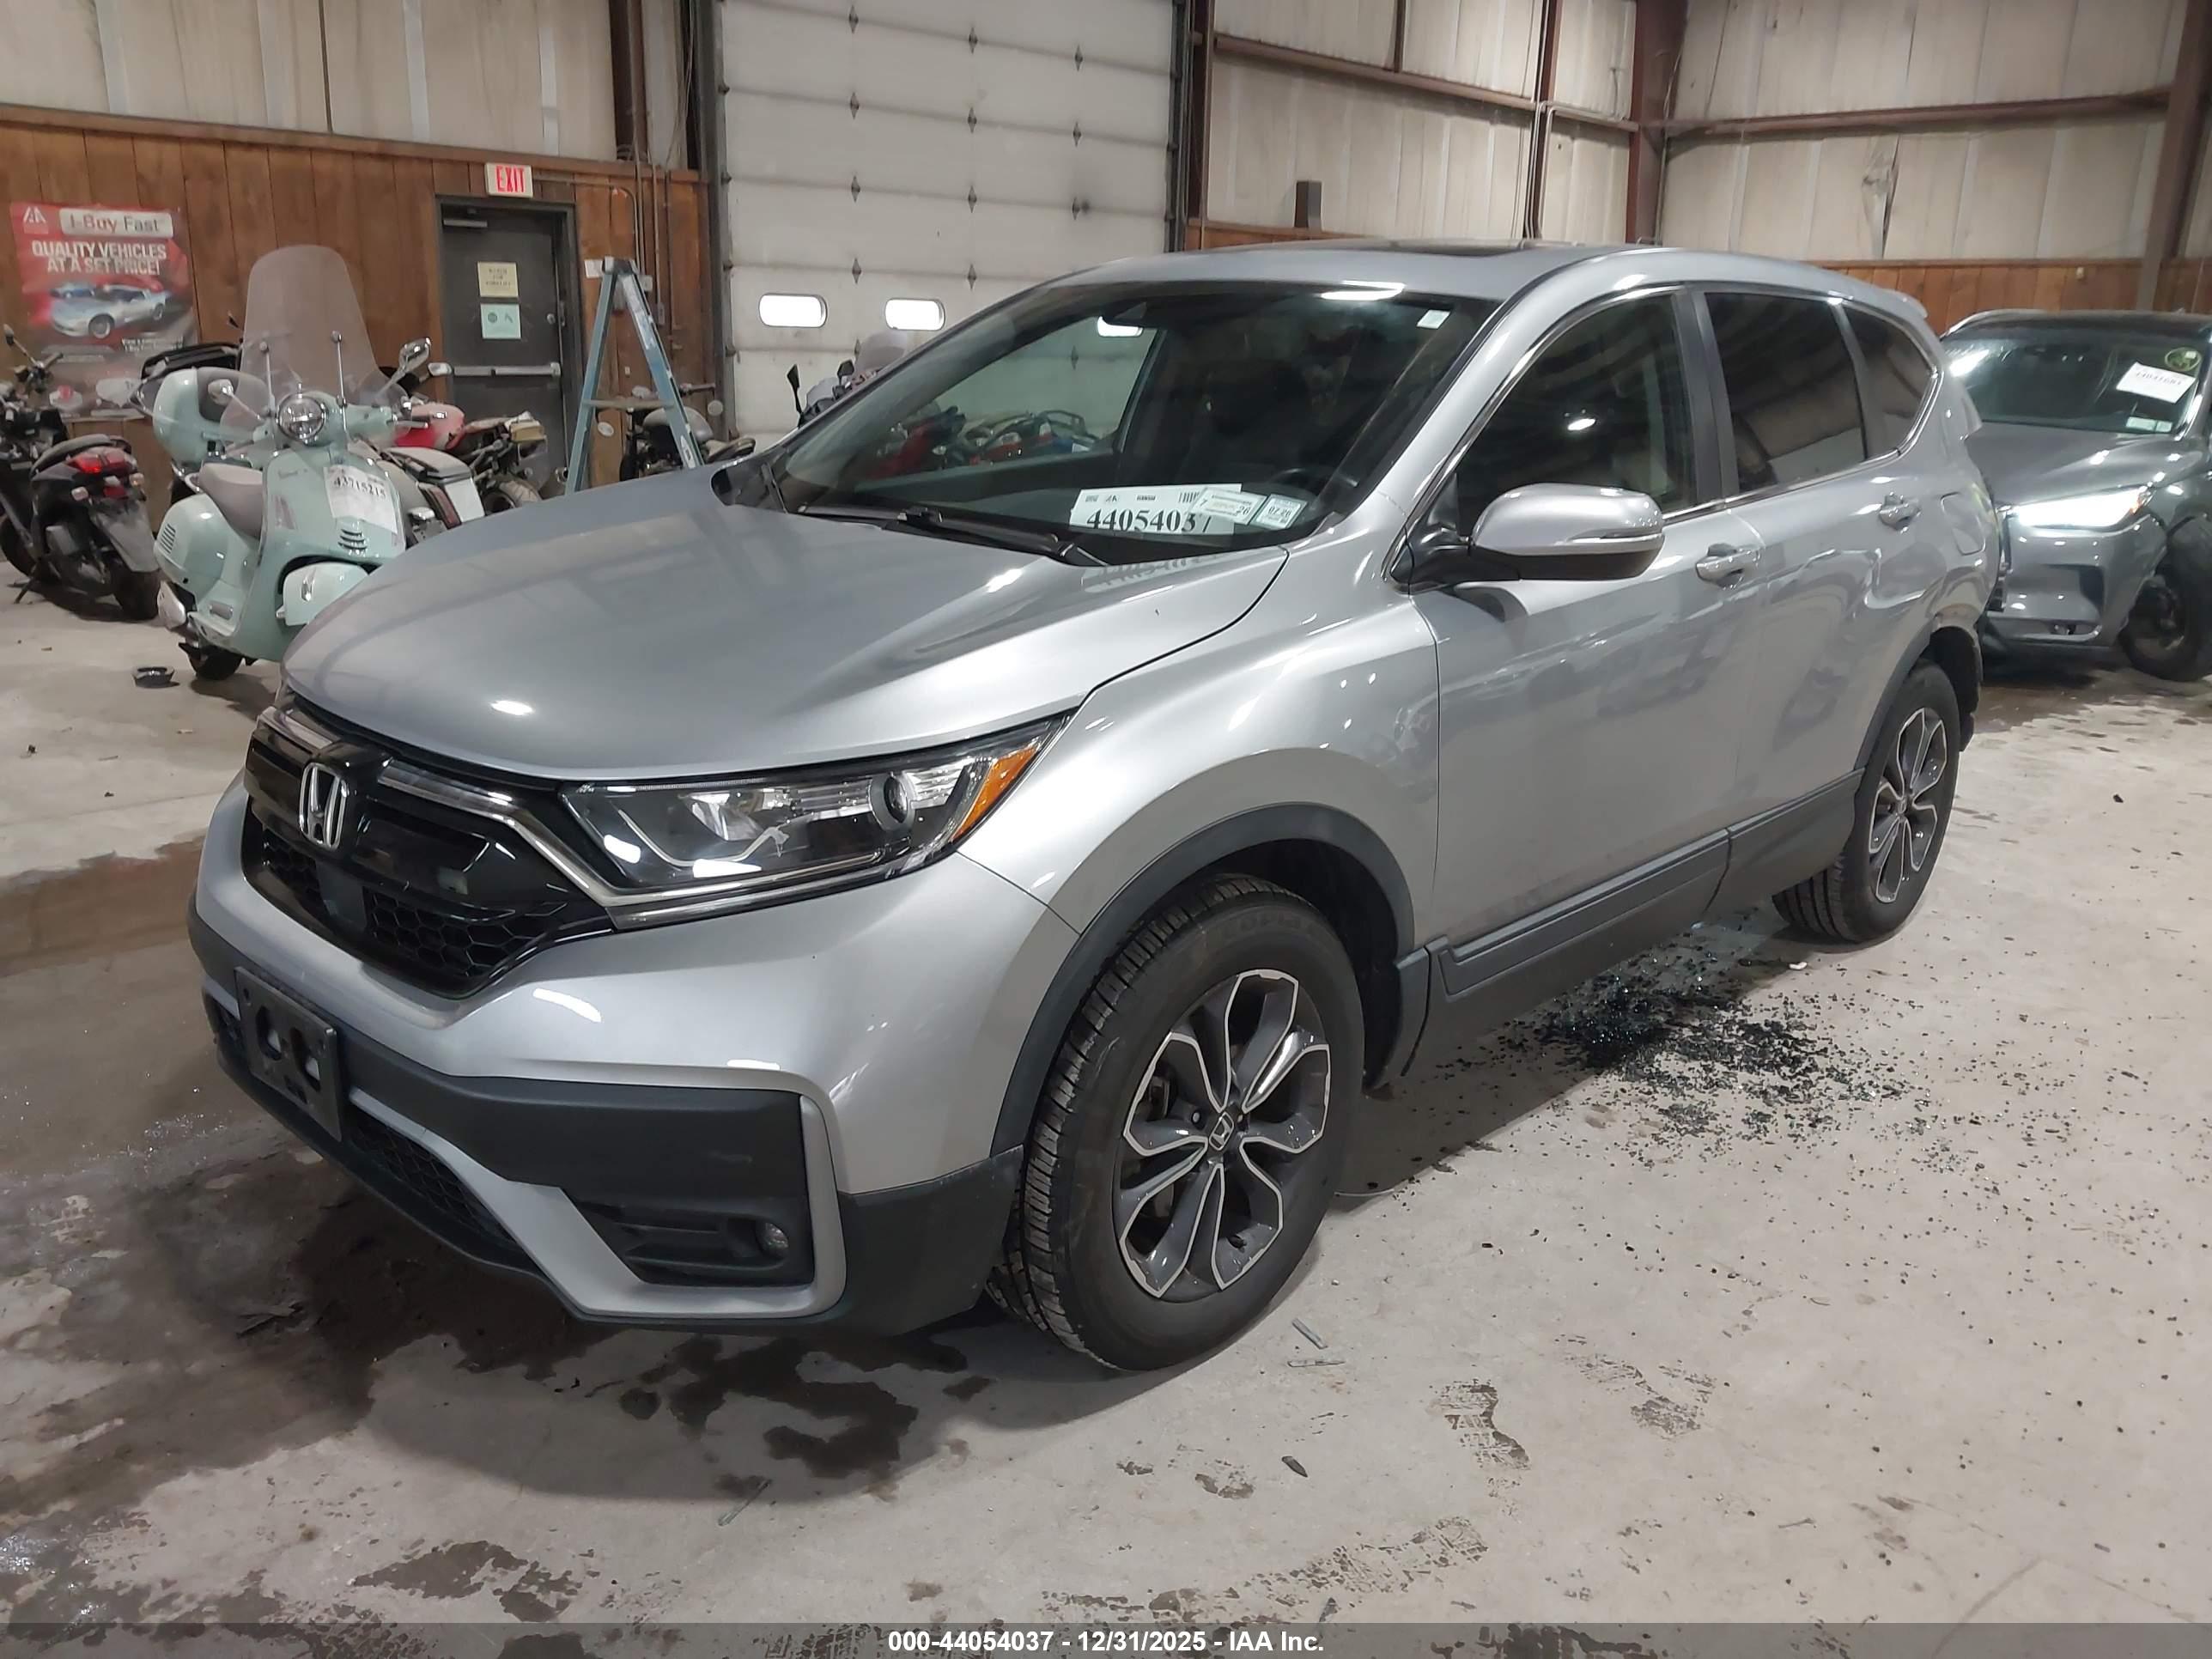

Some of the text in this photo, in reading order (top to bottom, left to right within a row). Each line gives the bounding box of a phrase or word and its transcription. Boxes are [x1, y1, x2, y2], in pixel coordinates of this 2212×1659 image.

[495, 165, 525, 193] EXIT
[123, 216, 161, 232] Fast
[32, 240, 167, 259] QUALITY VEHICLES
[47, 258, 161, 276] AT A SET PRICE!
